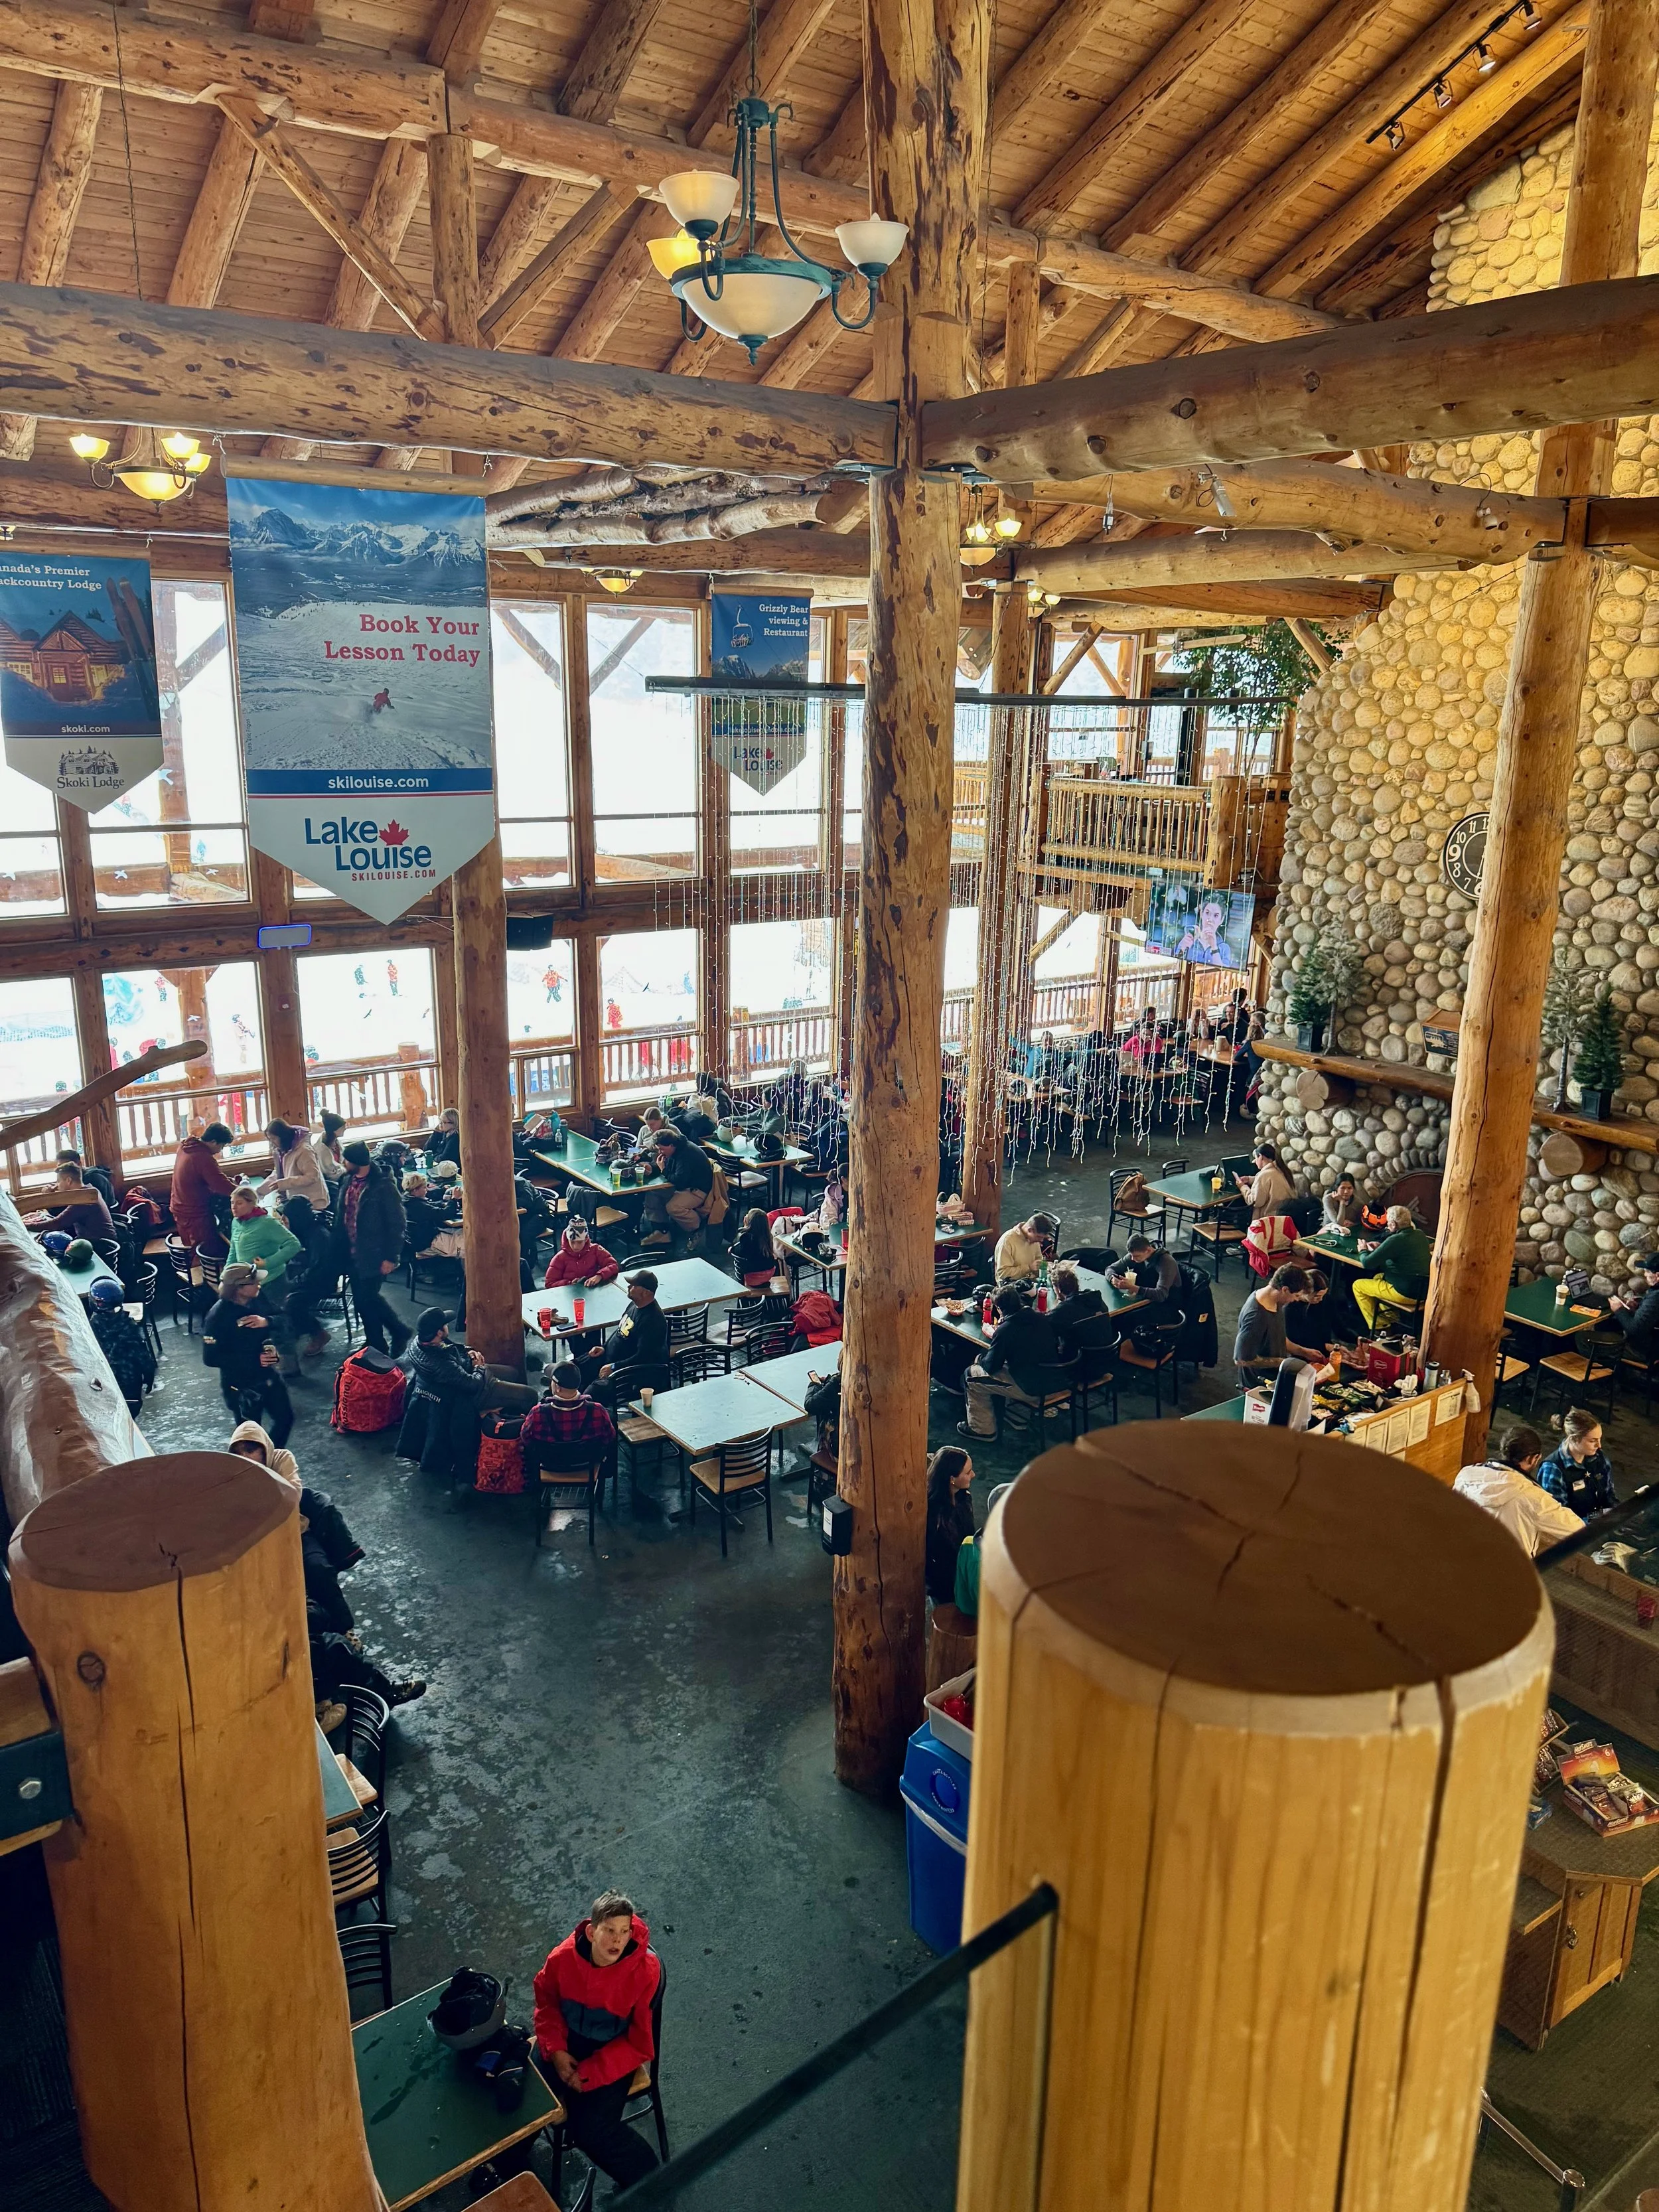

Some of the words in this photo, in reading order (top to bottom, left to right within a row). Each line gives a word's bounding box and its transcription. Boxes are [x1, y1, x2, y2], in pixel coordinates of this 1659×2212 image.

[44, 565, 90, 576] Premier
[68, 579, 102, 591] Lodge
[759, 604, 788, 615] Grizzly
[360, 614, 419, 633] Book
[426, 617, 479, 635] Your
[768, 616, 800, 627] viewing
[764, 628, 808, 636] Restaurant
[324, 640, 405, 661] Lesson
[412, 643, 480, 668] Today
[61, 725, 111, 733] skoki.com
[734, 746, 764, 759] Lake
[56, 776, 91, 789] Skoki
[92, 776, 125, 789] Lodge
[328, 776, 429, 789] skilouise.com
[305, 816, 378, 844] Lake
[1469, 820, 1477, 834] 11
[1456, 831, 1467, 844] 10
[335, 845, 431, 871] Louise
[1448, 844, 1461, 862] 9
[352, 869, 436, 881] SKILOUISE.COM
[1453, 862, 1461, 878] 8
[1463, 877, 1471, 890] 7
